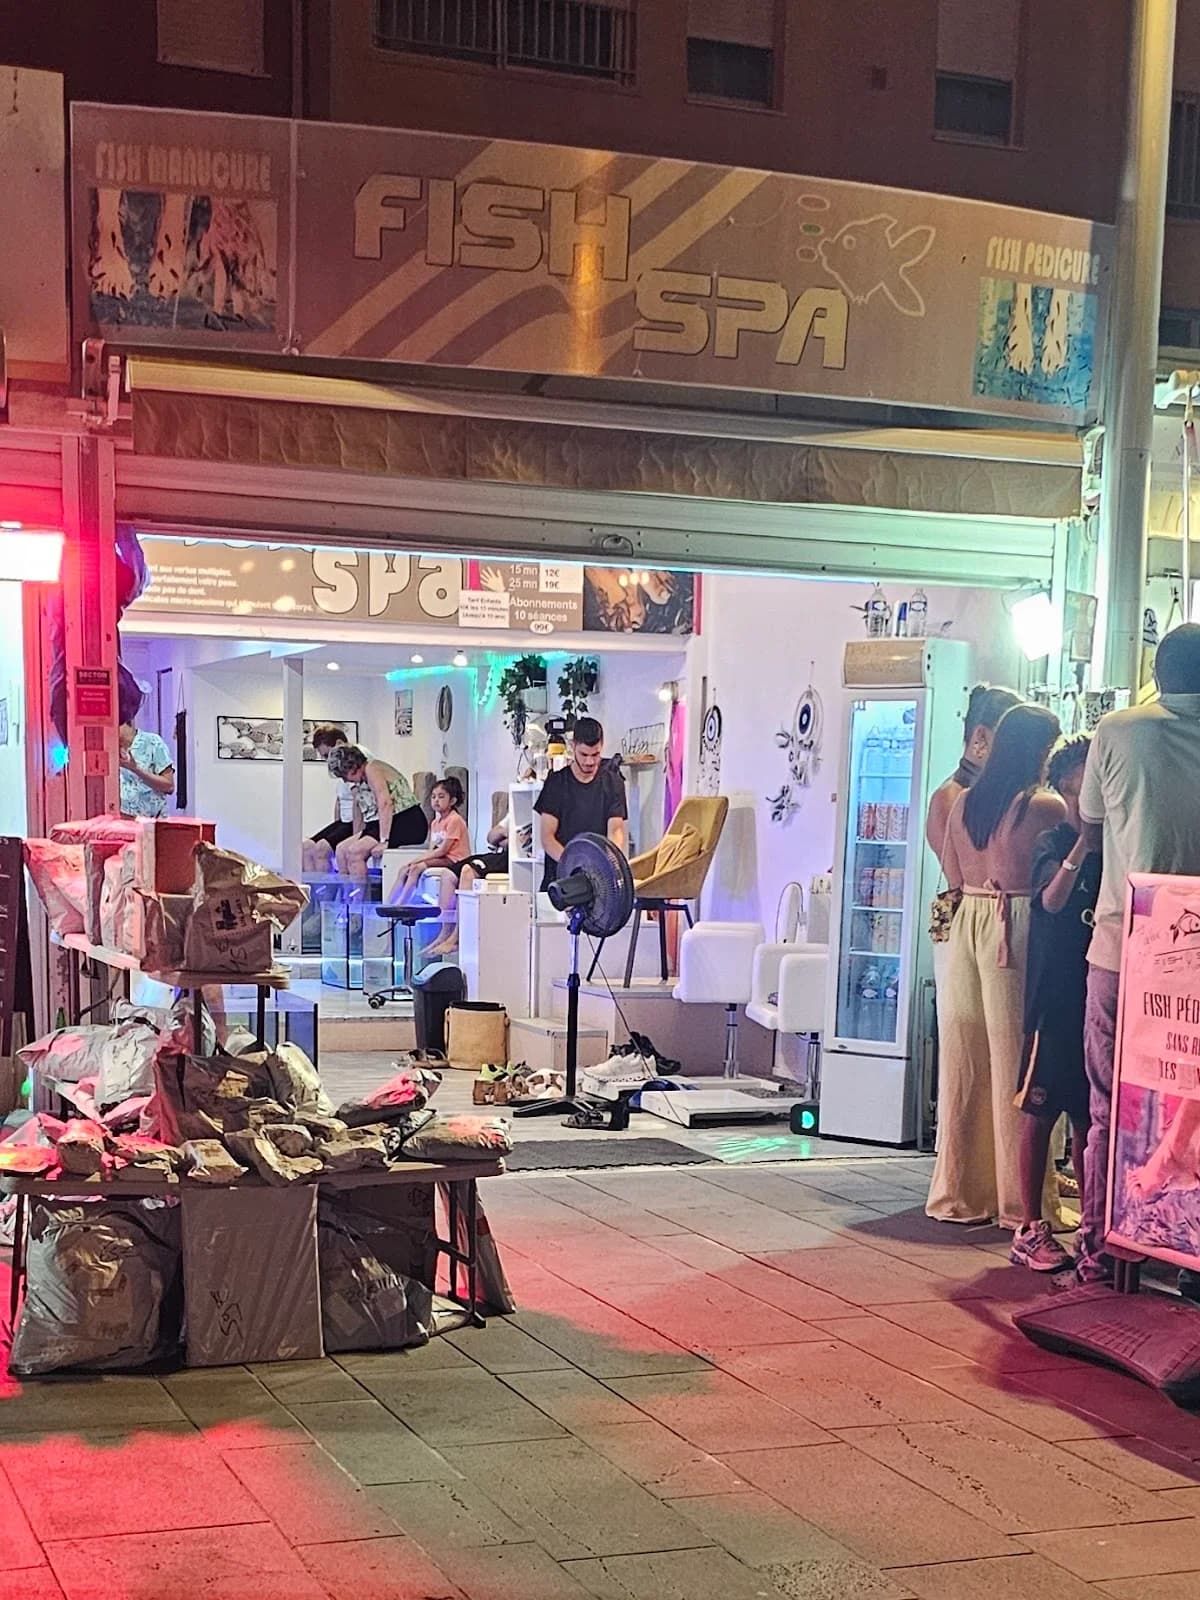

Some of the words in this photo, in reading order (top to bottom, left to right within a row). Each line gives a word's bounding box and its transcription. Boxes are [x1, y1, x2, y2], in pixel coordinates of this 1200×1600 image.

[96, 143, 142, 181] FISH
[353, 174, 631, 281] FISH
[986, 236, 1022, 272] FISH
[1023, 242, 1100, 285] PEDICURE
[633, 268, 850, 370] SPA
[510, 596, 578, 610] Abonnements
[515, 610, 526, 620] 10
[1143, 991, 1171, 1019] FISH
